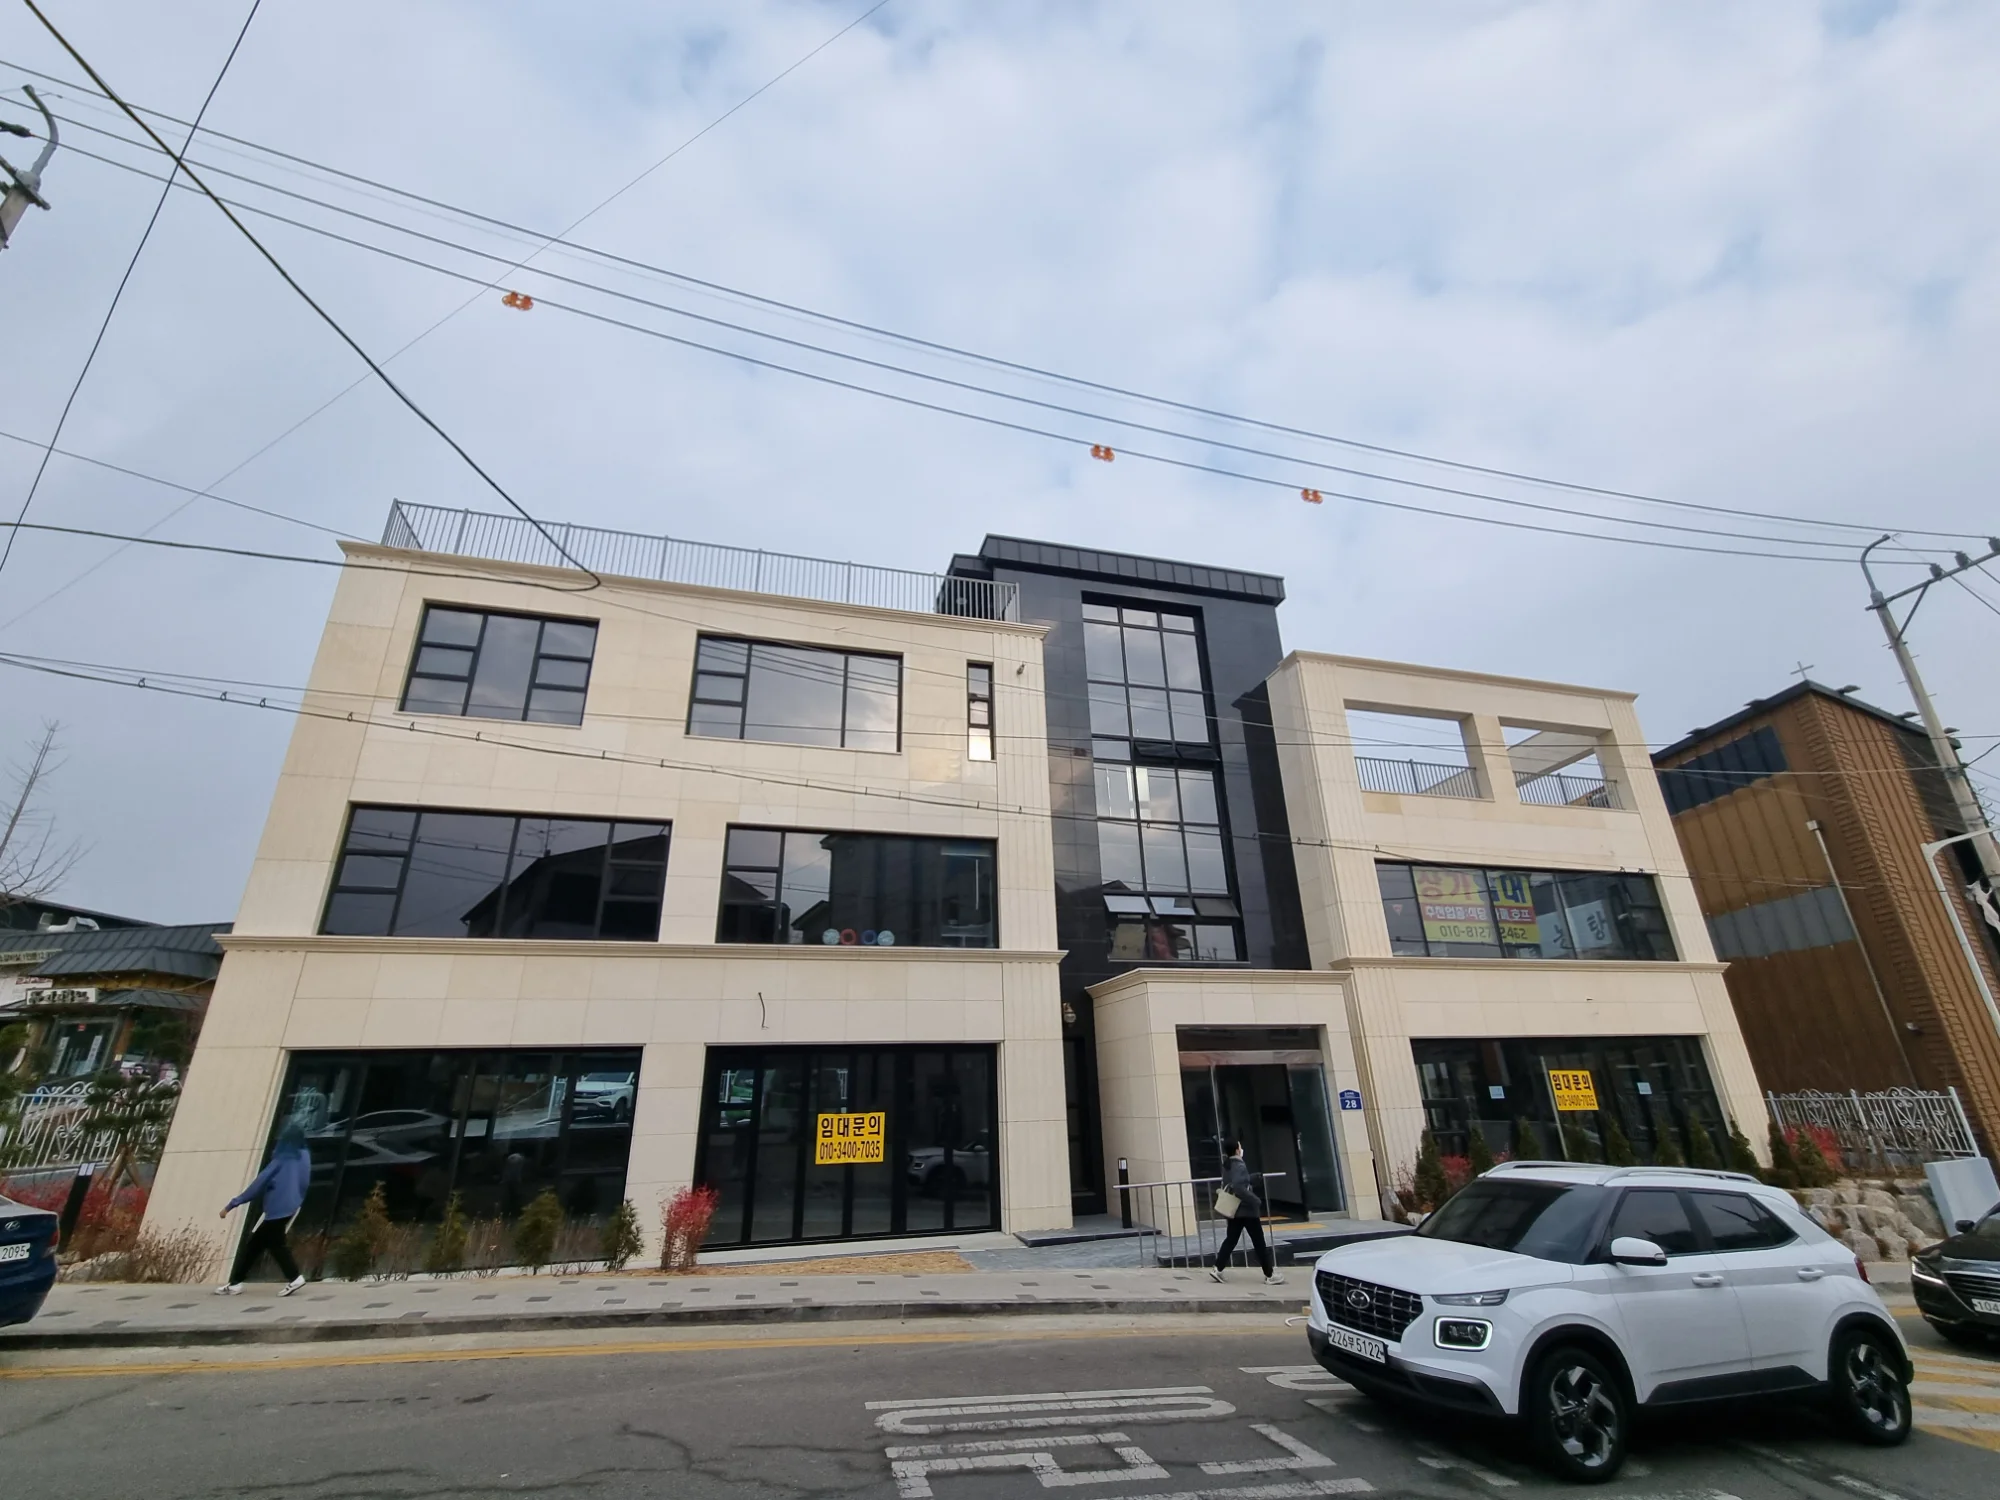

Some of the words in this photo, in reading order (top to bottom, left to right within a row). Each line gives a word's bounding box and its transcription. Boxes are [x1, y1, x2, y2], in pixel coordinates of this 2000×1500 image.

[1552, 1074, 1591, 1090] 임대문의
[1345, 1100, 1357, 1108] 28
[821, 1116, 881, 1138] 임대문의
[819, 1141, 881, 1160] 010-3400-7035
[2, 1245, 26, 1260] 2095
